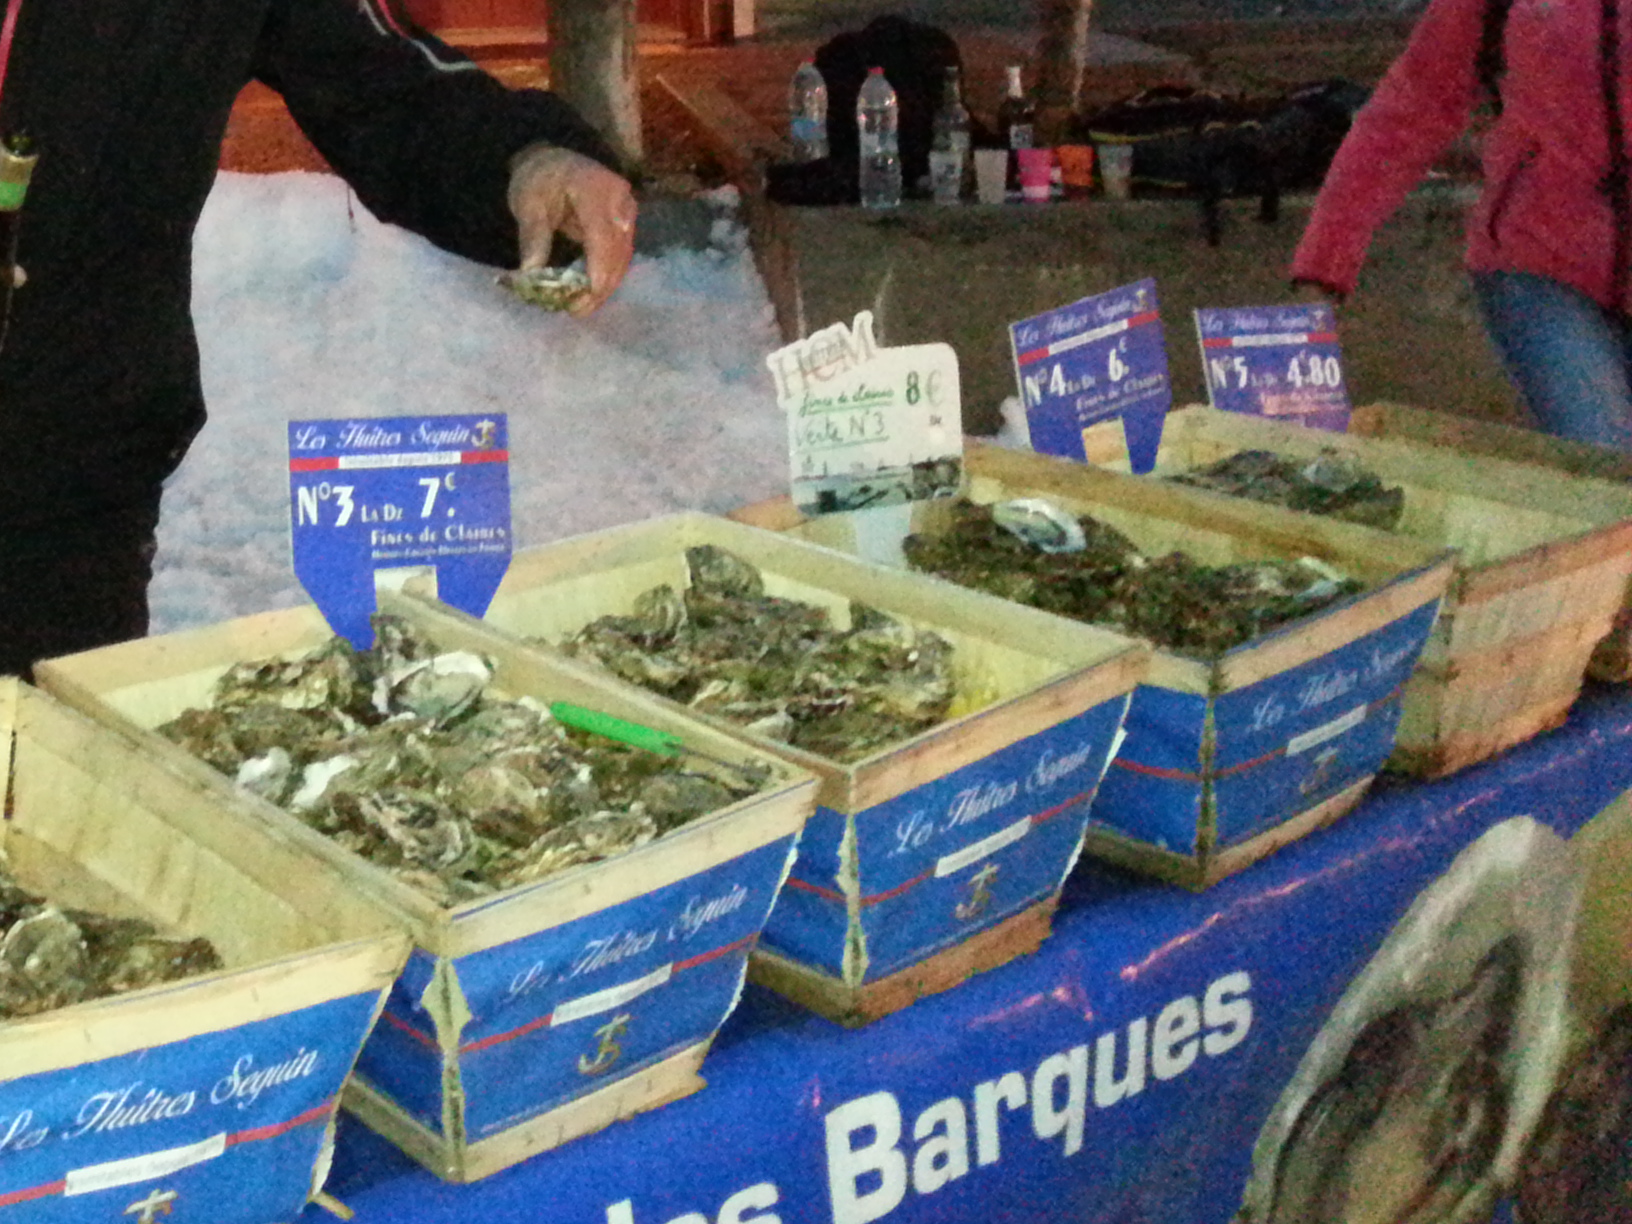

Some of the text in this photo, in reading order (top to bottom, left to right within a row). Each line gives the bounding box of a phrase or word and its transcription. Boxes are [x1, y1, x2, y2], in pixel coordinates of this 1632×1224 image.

[294, 426, 327, 449] Les
[411, 421, 470, 451] Seguin
[210, 1047, 318, 1110] Seguin
[824, 971, 1253, 1224] Barques
